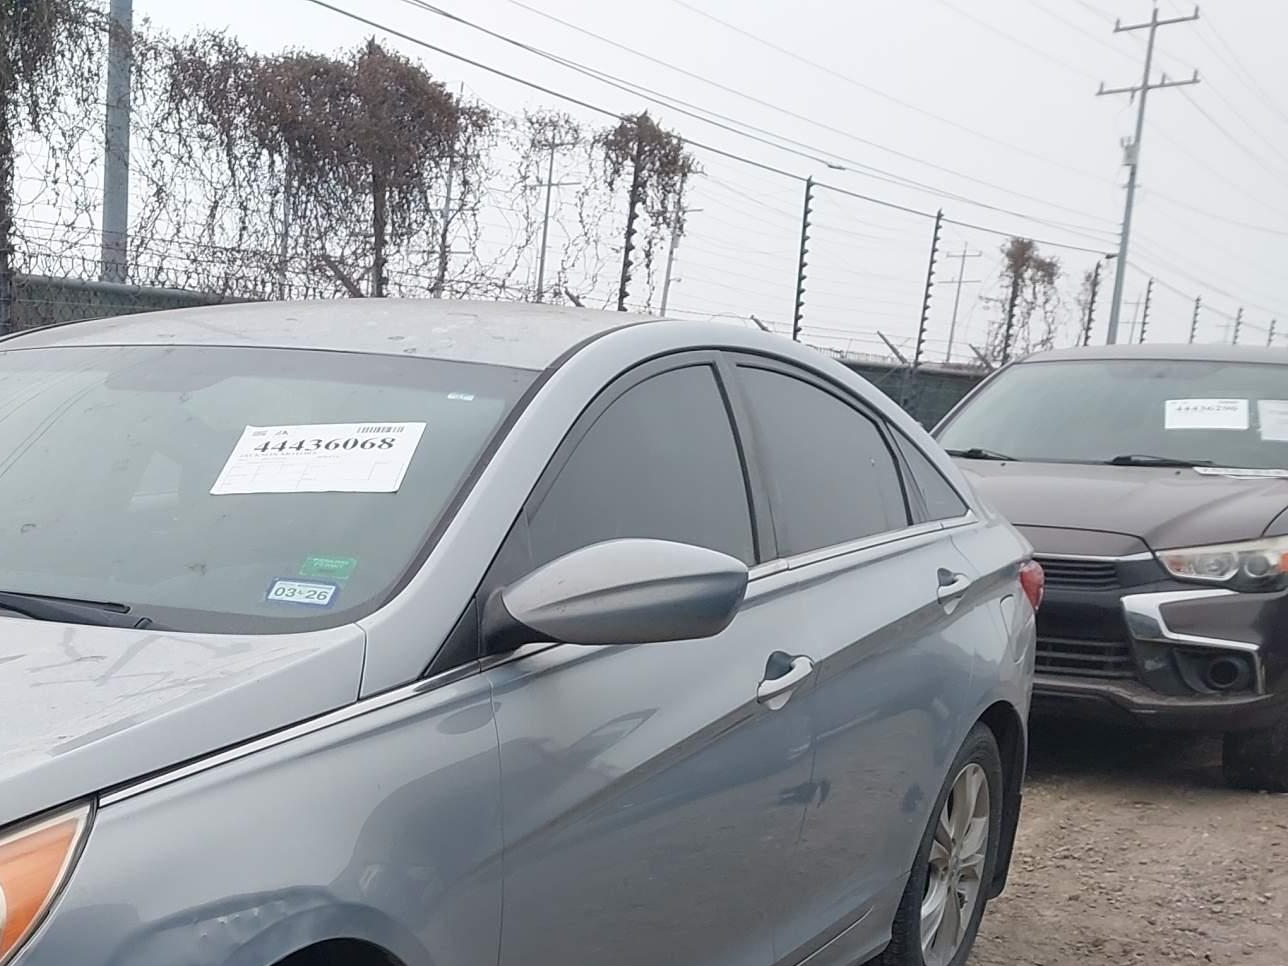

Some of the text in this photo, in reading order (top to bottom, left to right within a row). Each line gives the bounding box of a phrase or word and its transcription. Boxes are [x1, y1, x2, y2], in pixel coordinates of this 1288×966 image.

[253, 437, 396, 454] 44436068
[274, 586, 328, 601] 03 26
